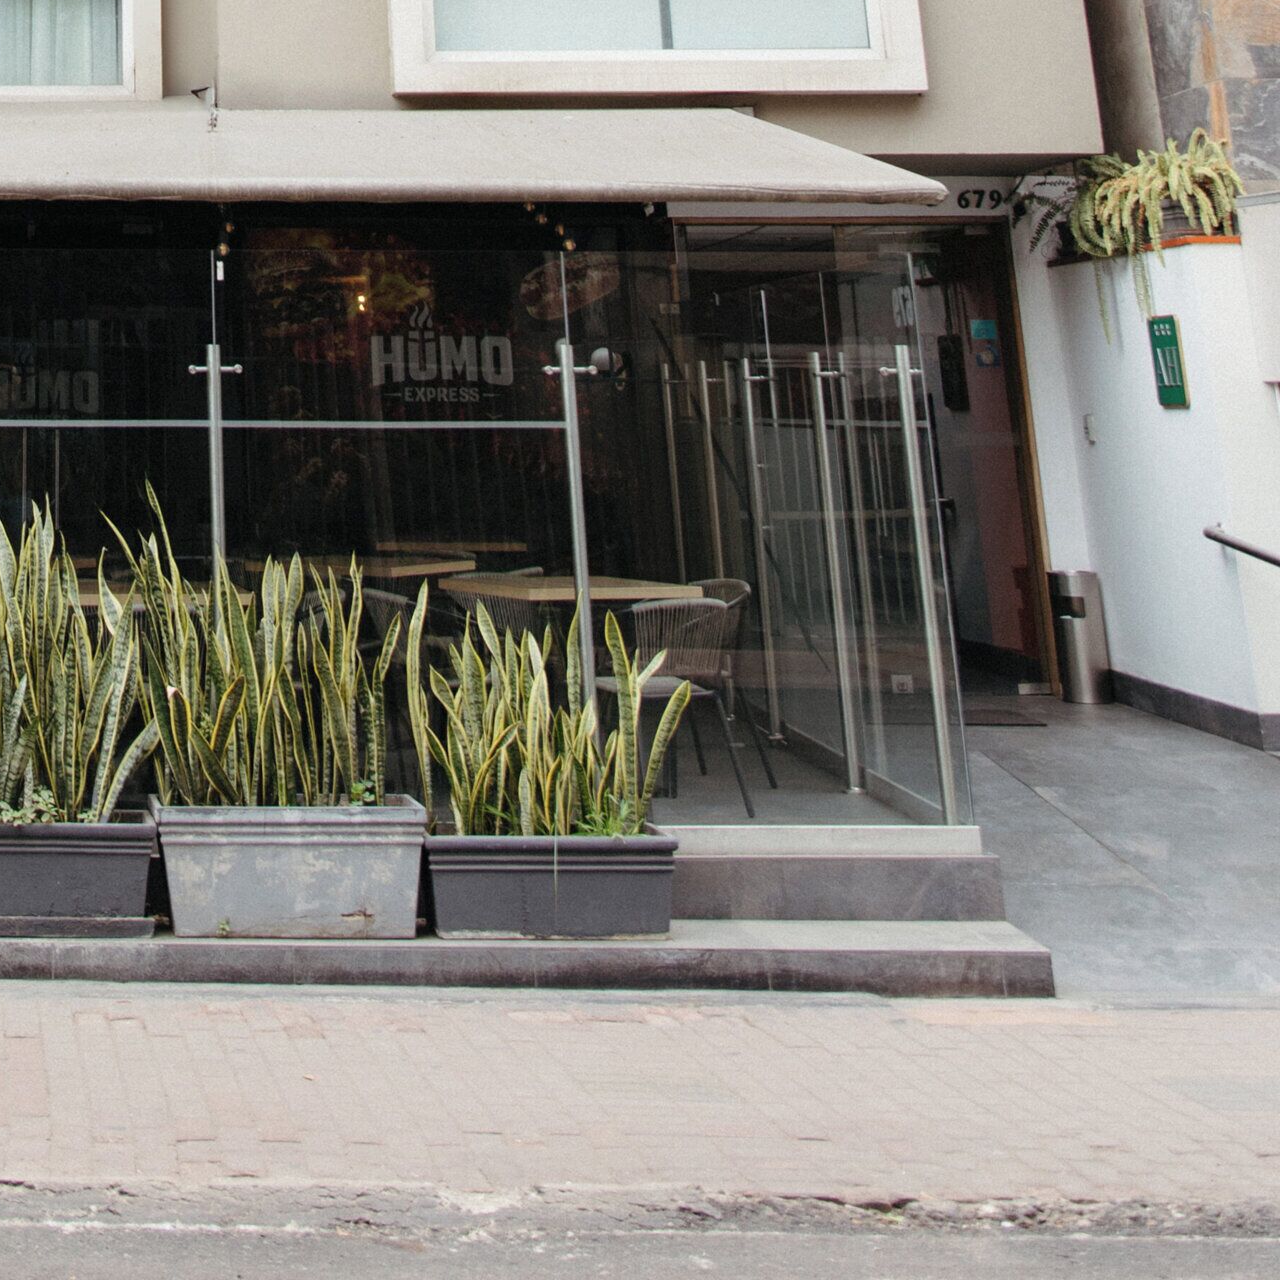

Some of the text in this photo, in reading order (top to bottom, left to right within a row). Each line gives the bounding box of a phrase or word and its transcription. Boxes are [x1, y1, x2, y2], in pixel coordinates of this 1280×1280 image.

[957, 190, 1002, 209] 679
[370, 330, 514, 387] HÜMO
[404, 387, 480, 402] EXPRESS
